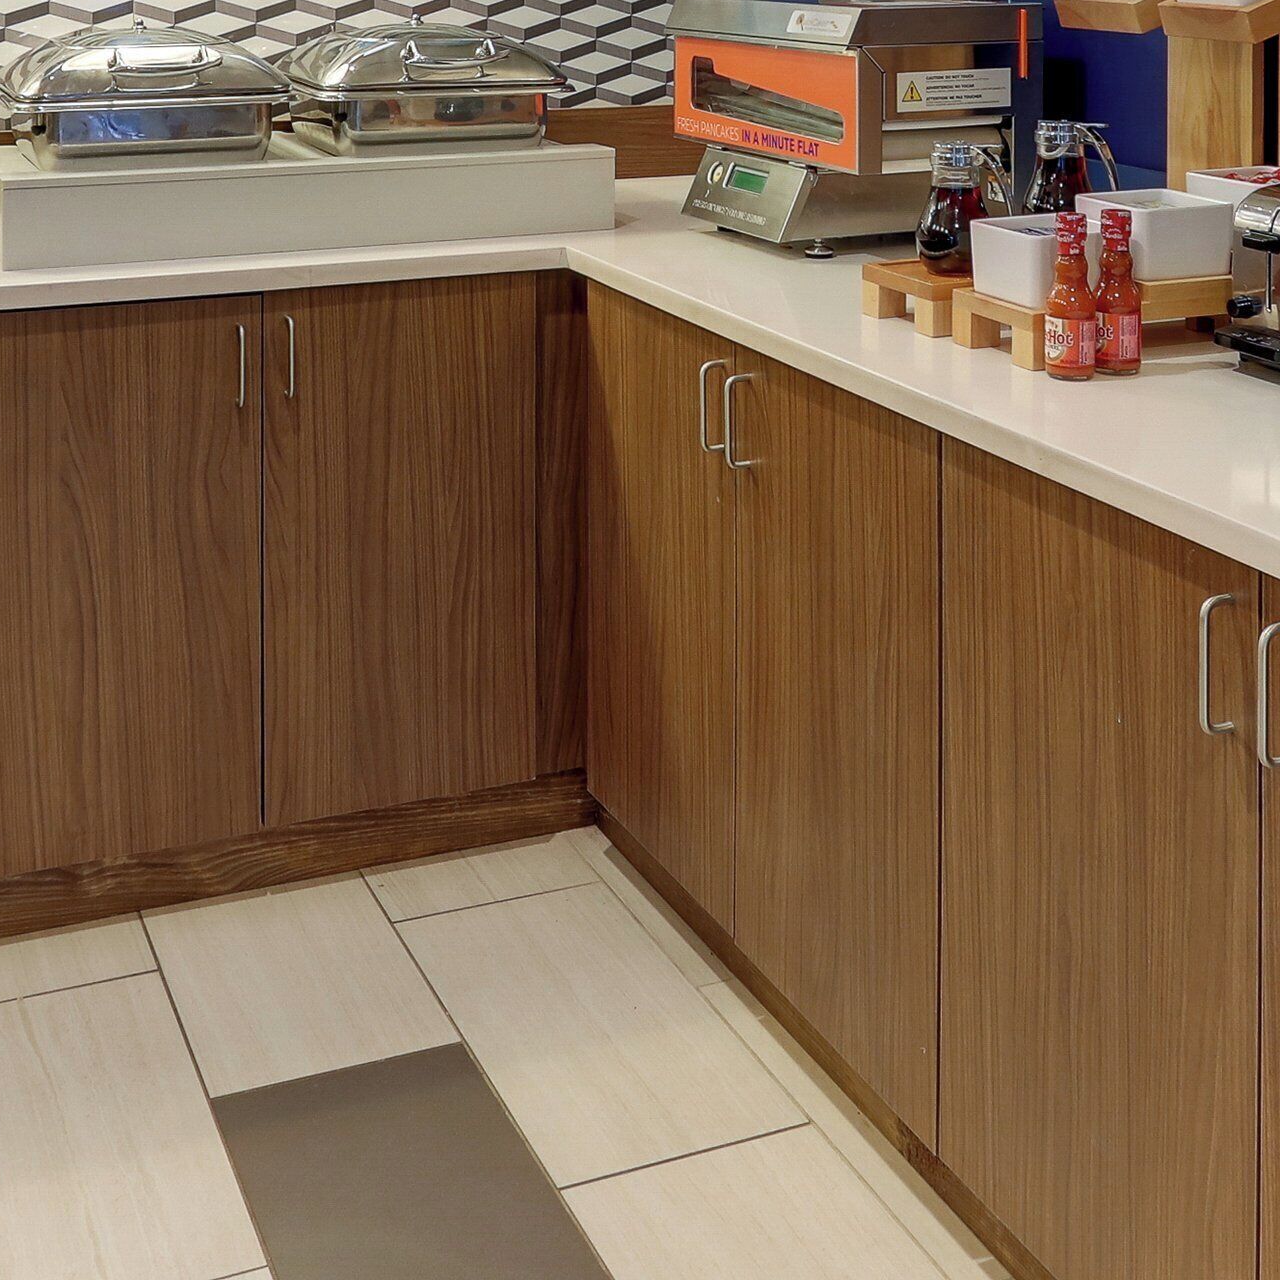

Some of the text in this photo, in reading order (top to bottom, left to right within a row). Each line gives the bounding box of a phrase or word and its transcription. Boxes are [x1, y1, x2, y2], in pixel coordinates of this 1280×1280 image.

[677, 117, 819, 156] FRESH PANCAKES IN A MINUTE FLAT
